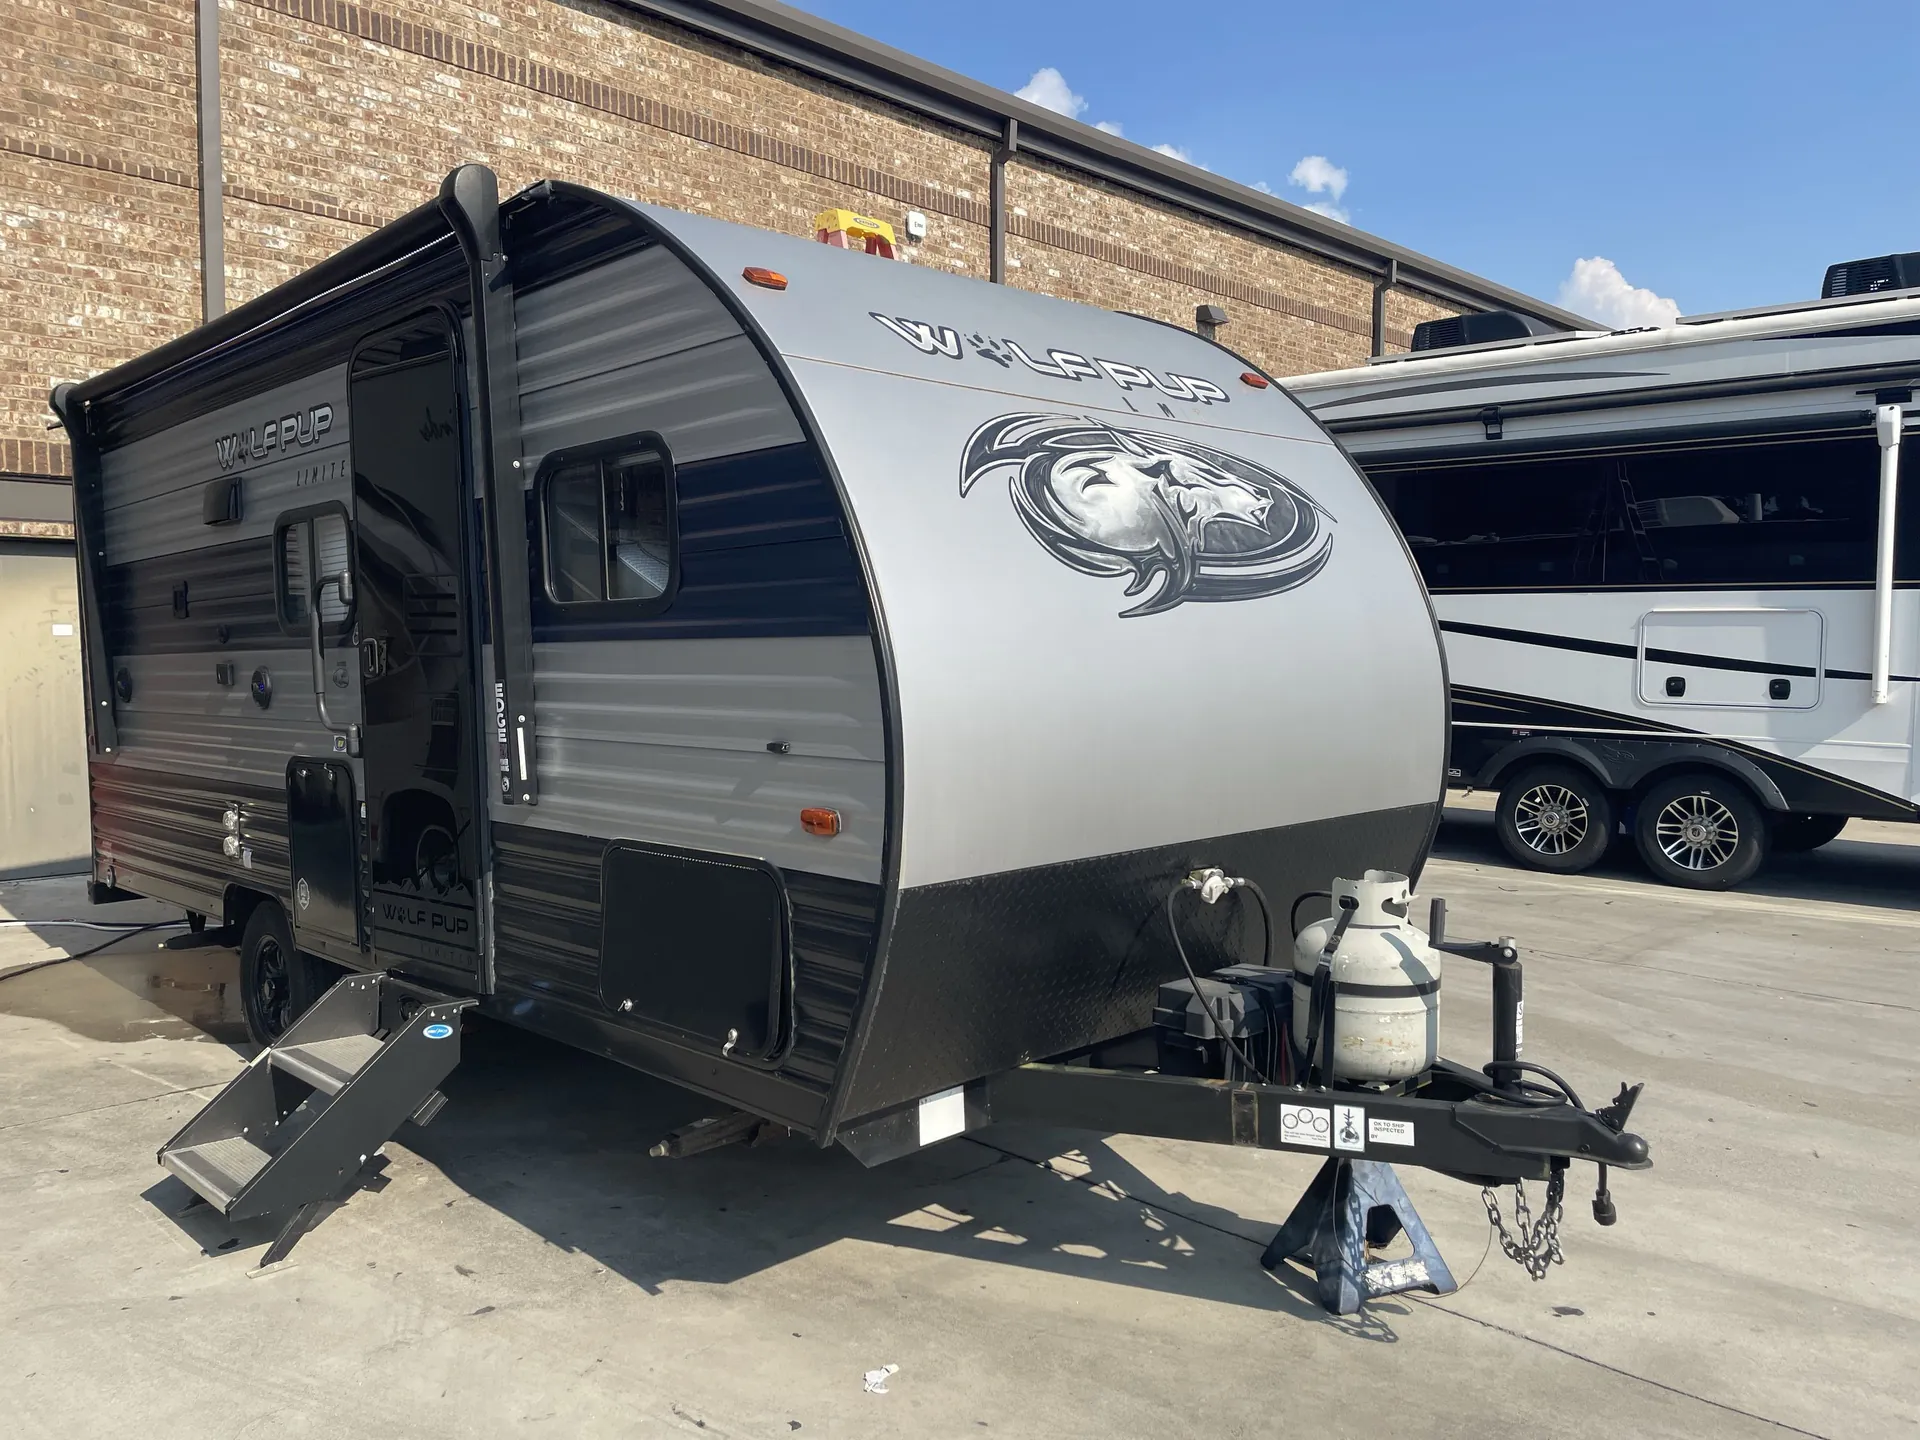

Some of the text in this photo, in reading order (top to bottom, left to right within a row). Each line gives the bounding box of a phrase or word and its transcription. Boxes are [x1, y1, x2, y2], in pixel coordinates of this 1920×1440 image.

[1094, 357, 1231, 405] PUP
[280, 402, 334, 453] PUP
[296, 459, 346, 487] LIMITE
[494, 682, 507, 743] EDGE
[431, 912, 469, 935] PUP
[1373, 1126, 1405, 1134] INSPECTED
